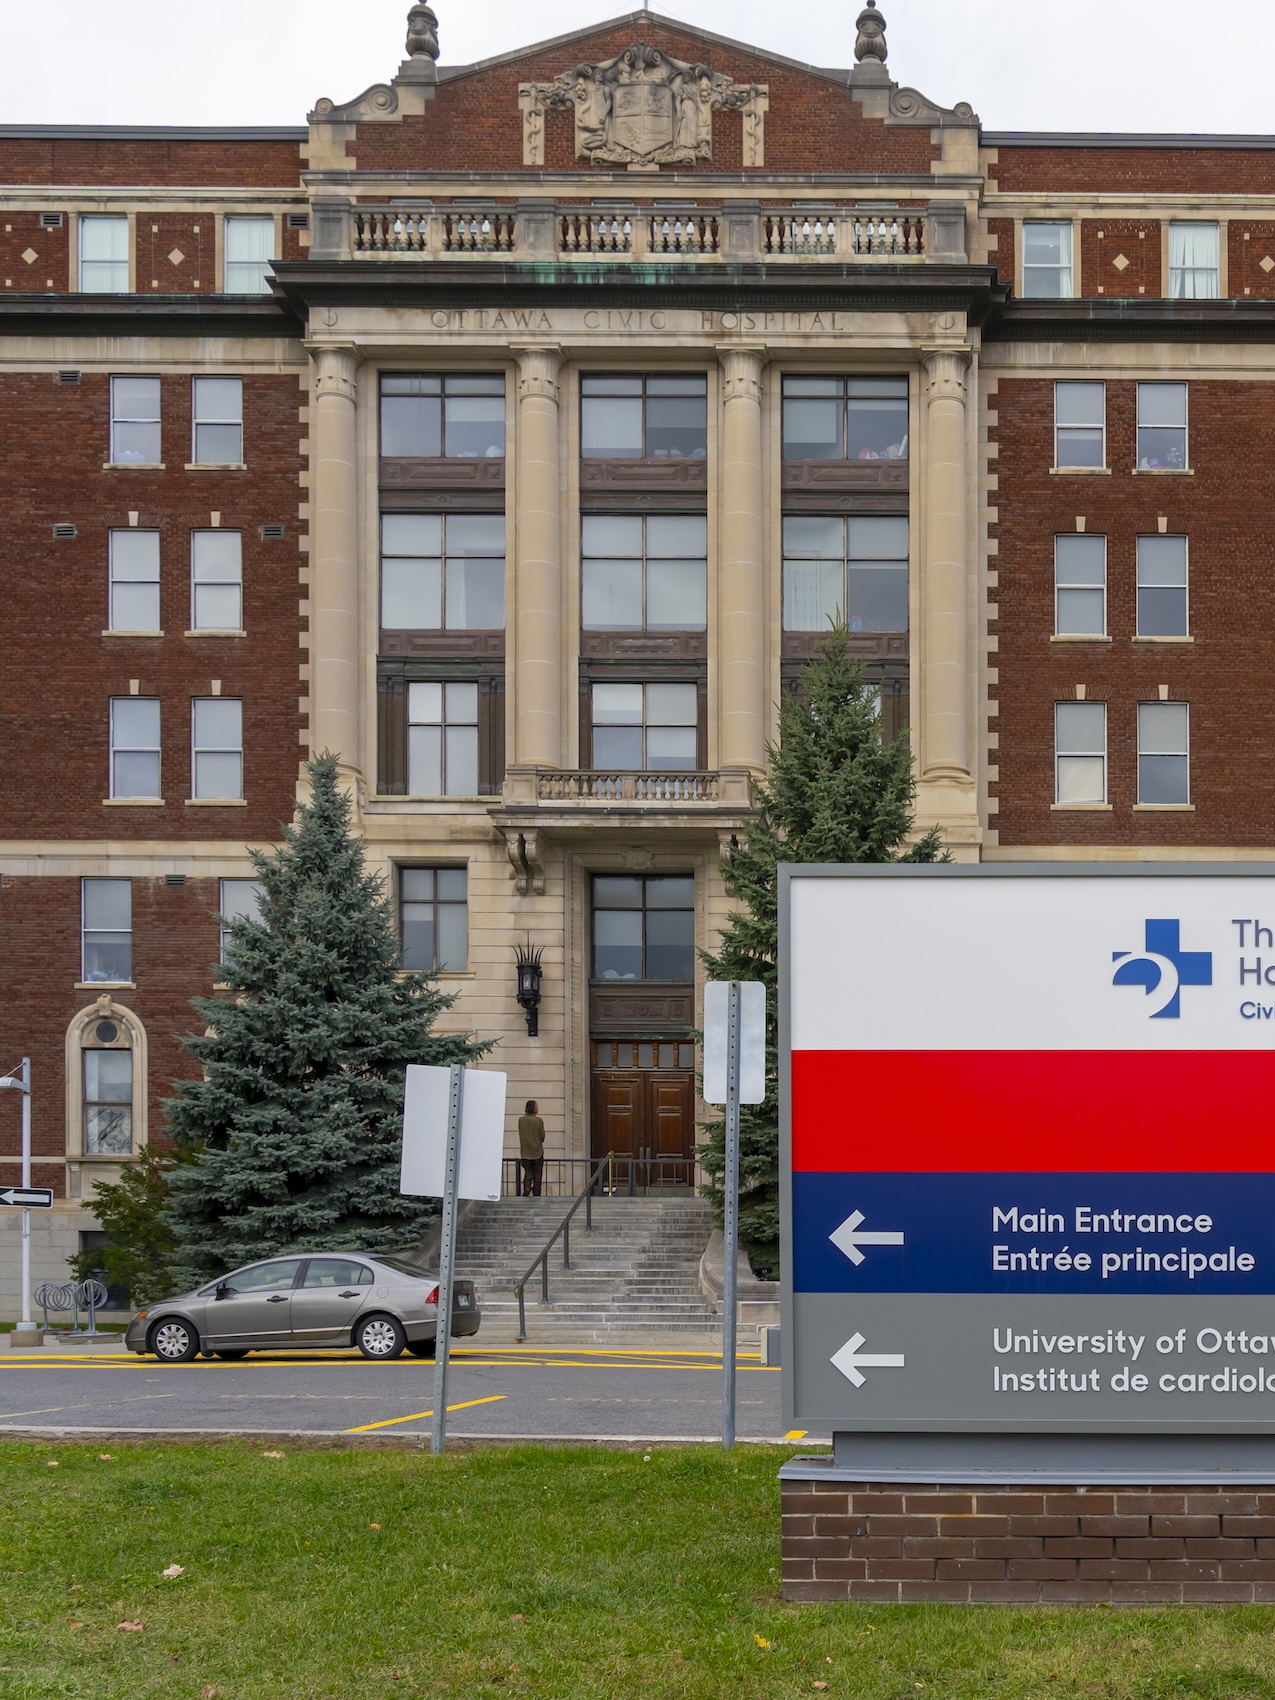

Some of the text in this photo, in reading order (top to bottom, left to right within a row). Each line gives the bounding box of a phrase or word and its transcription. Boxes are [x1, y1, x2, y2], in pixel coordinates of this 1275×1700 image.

[430, 310, 844, 331] OTTAWA CIVIC HOSPITAL
[992, 1206, 1213, 1233] Main Entrance
[992, 1245, 1256, 1279] Entrée principale
[993, 1327, 1146, 1361] University
[1155, 1328, 1187, 1355] of
[993, 1366, 1101, 1393] Institut
[1110, 1366, 1149, 1393] de
